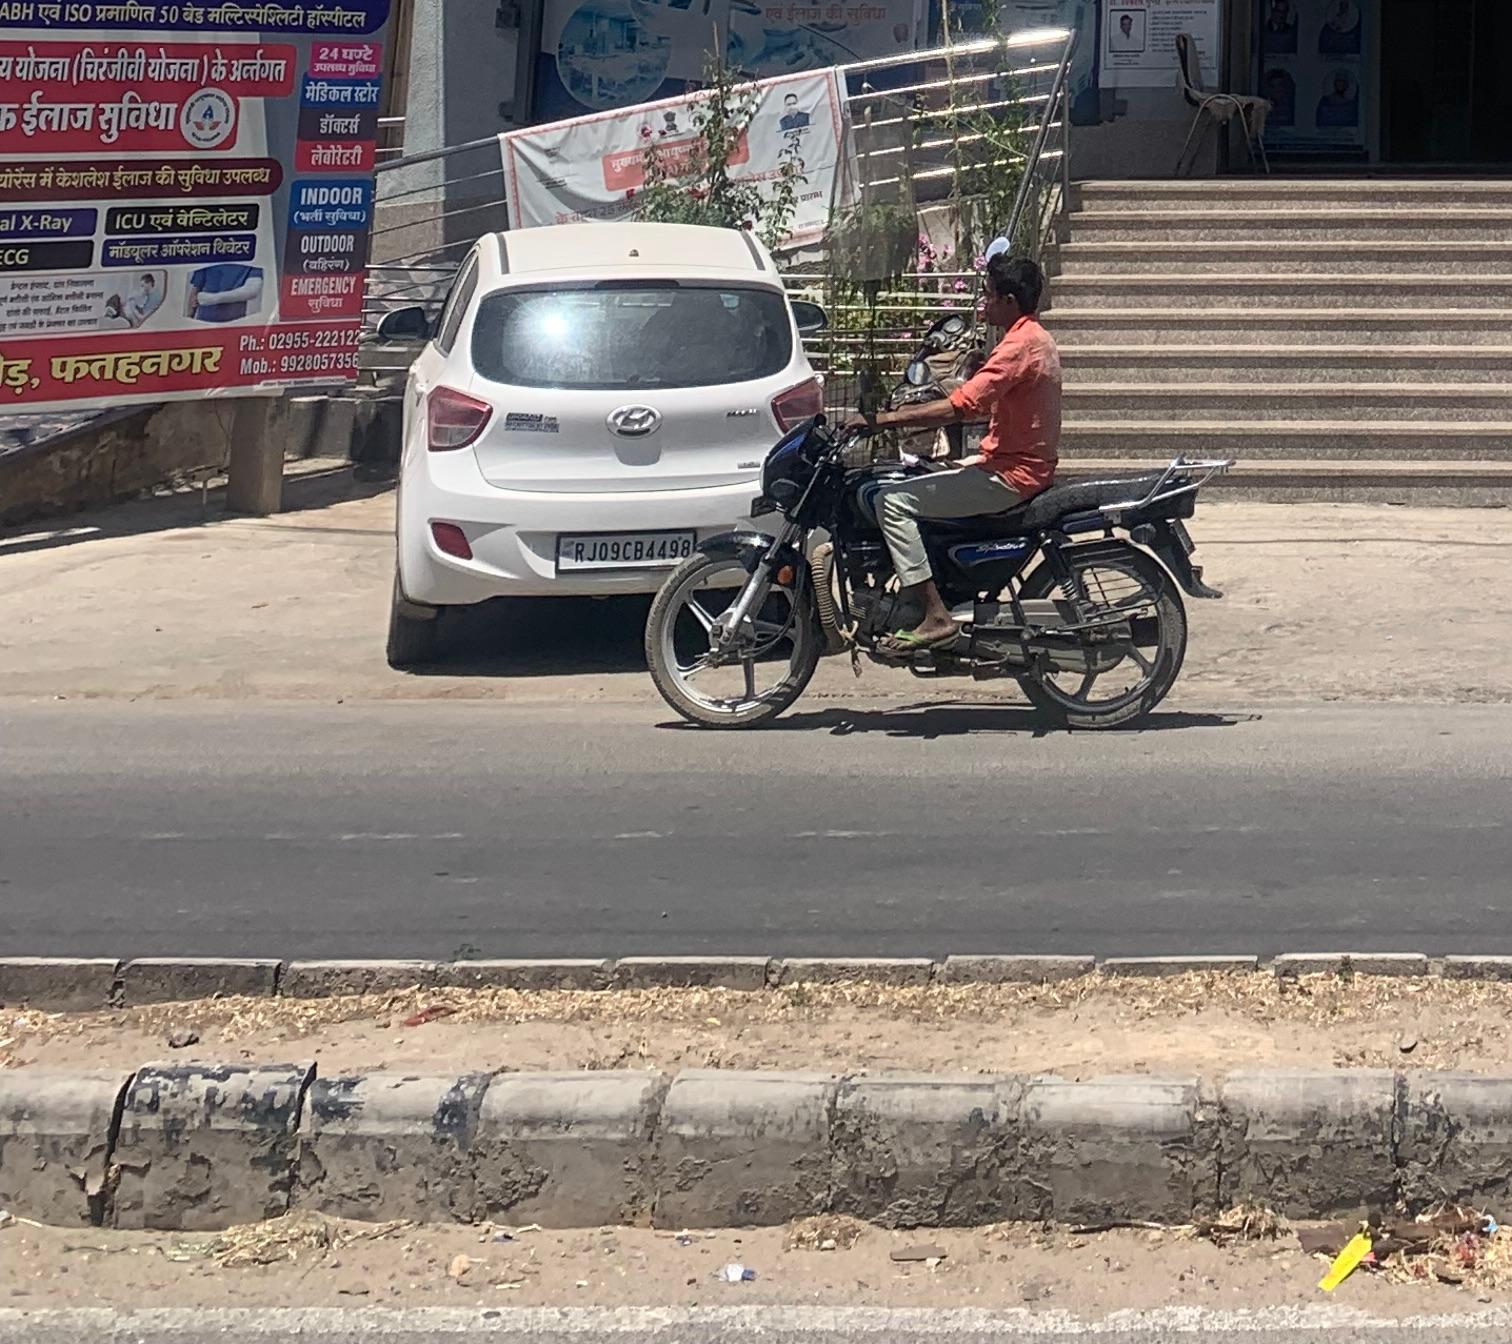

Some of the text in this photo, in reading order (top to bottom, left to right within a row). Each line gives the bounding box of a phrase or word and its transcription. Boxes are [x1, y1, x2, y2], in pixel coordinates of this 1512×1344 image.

[64, 4, 92, 22] ISO
[95, 0, 156, 24] प्रमाणित
[160, 7, 179, 23] 50
[182, 4, 206, 25] बेड
[306, 5, 366, 29] हॉस्पीटल
[14, 45, 71, 82] योजना
[148, 48, 199, 82] योजना
[211, 48, 225, 82] के
[319, 44, 374, 61] 24 घण्टे
[305, 81, 380, 103] मेडिकल स्टोर
[21, 90, 96, 136] ईलाज
[99, 91, 178, 144] सुविधा
[319, 113, 361, 134] डॉक्टर्स
[39, 164, 271, 192] में केशलेश ईलाज की सुविधा उपलब्ध
[300, 187, 363, 206] INDOOR
[20, 214, 73, 234] X-Ray
[115, 207, 249, 231] ICU एवं वेन्टिलेटर
[293, 208, 367, 226] (भर्ती सुविधा)
[161, 238, 210, 260] ऑपरेशन
[300, 234, 355, 254] OUTDOOR
[290, 276, 357, 297] EMERGENCY
[307, 295, 343, 314] सुविधा
[239, 329, 361, 351] Ph.: 02955-222122
[51, 346, 224, 384] फतहनगर
[239, 352, 360, 376] Mob.: 9928057356
[573, 538, 691, 562] RJ09CB4498
